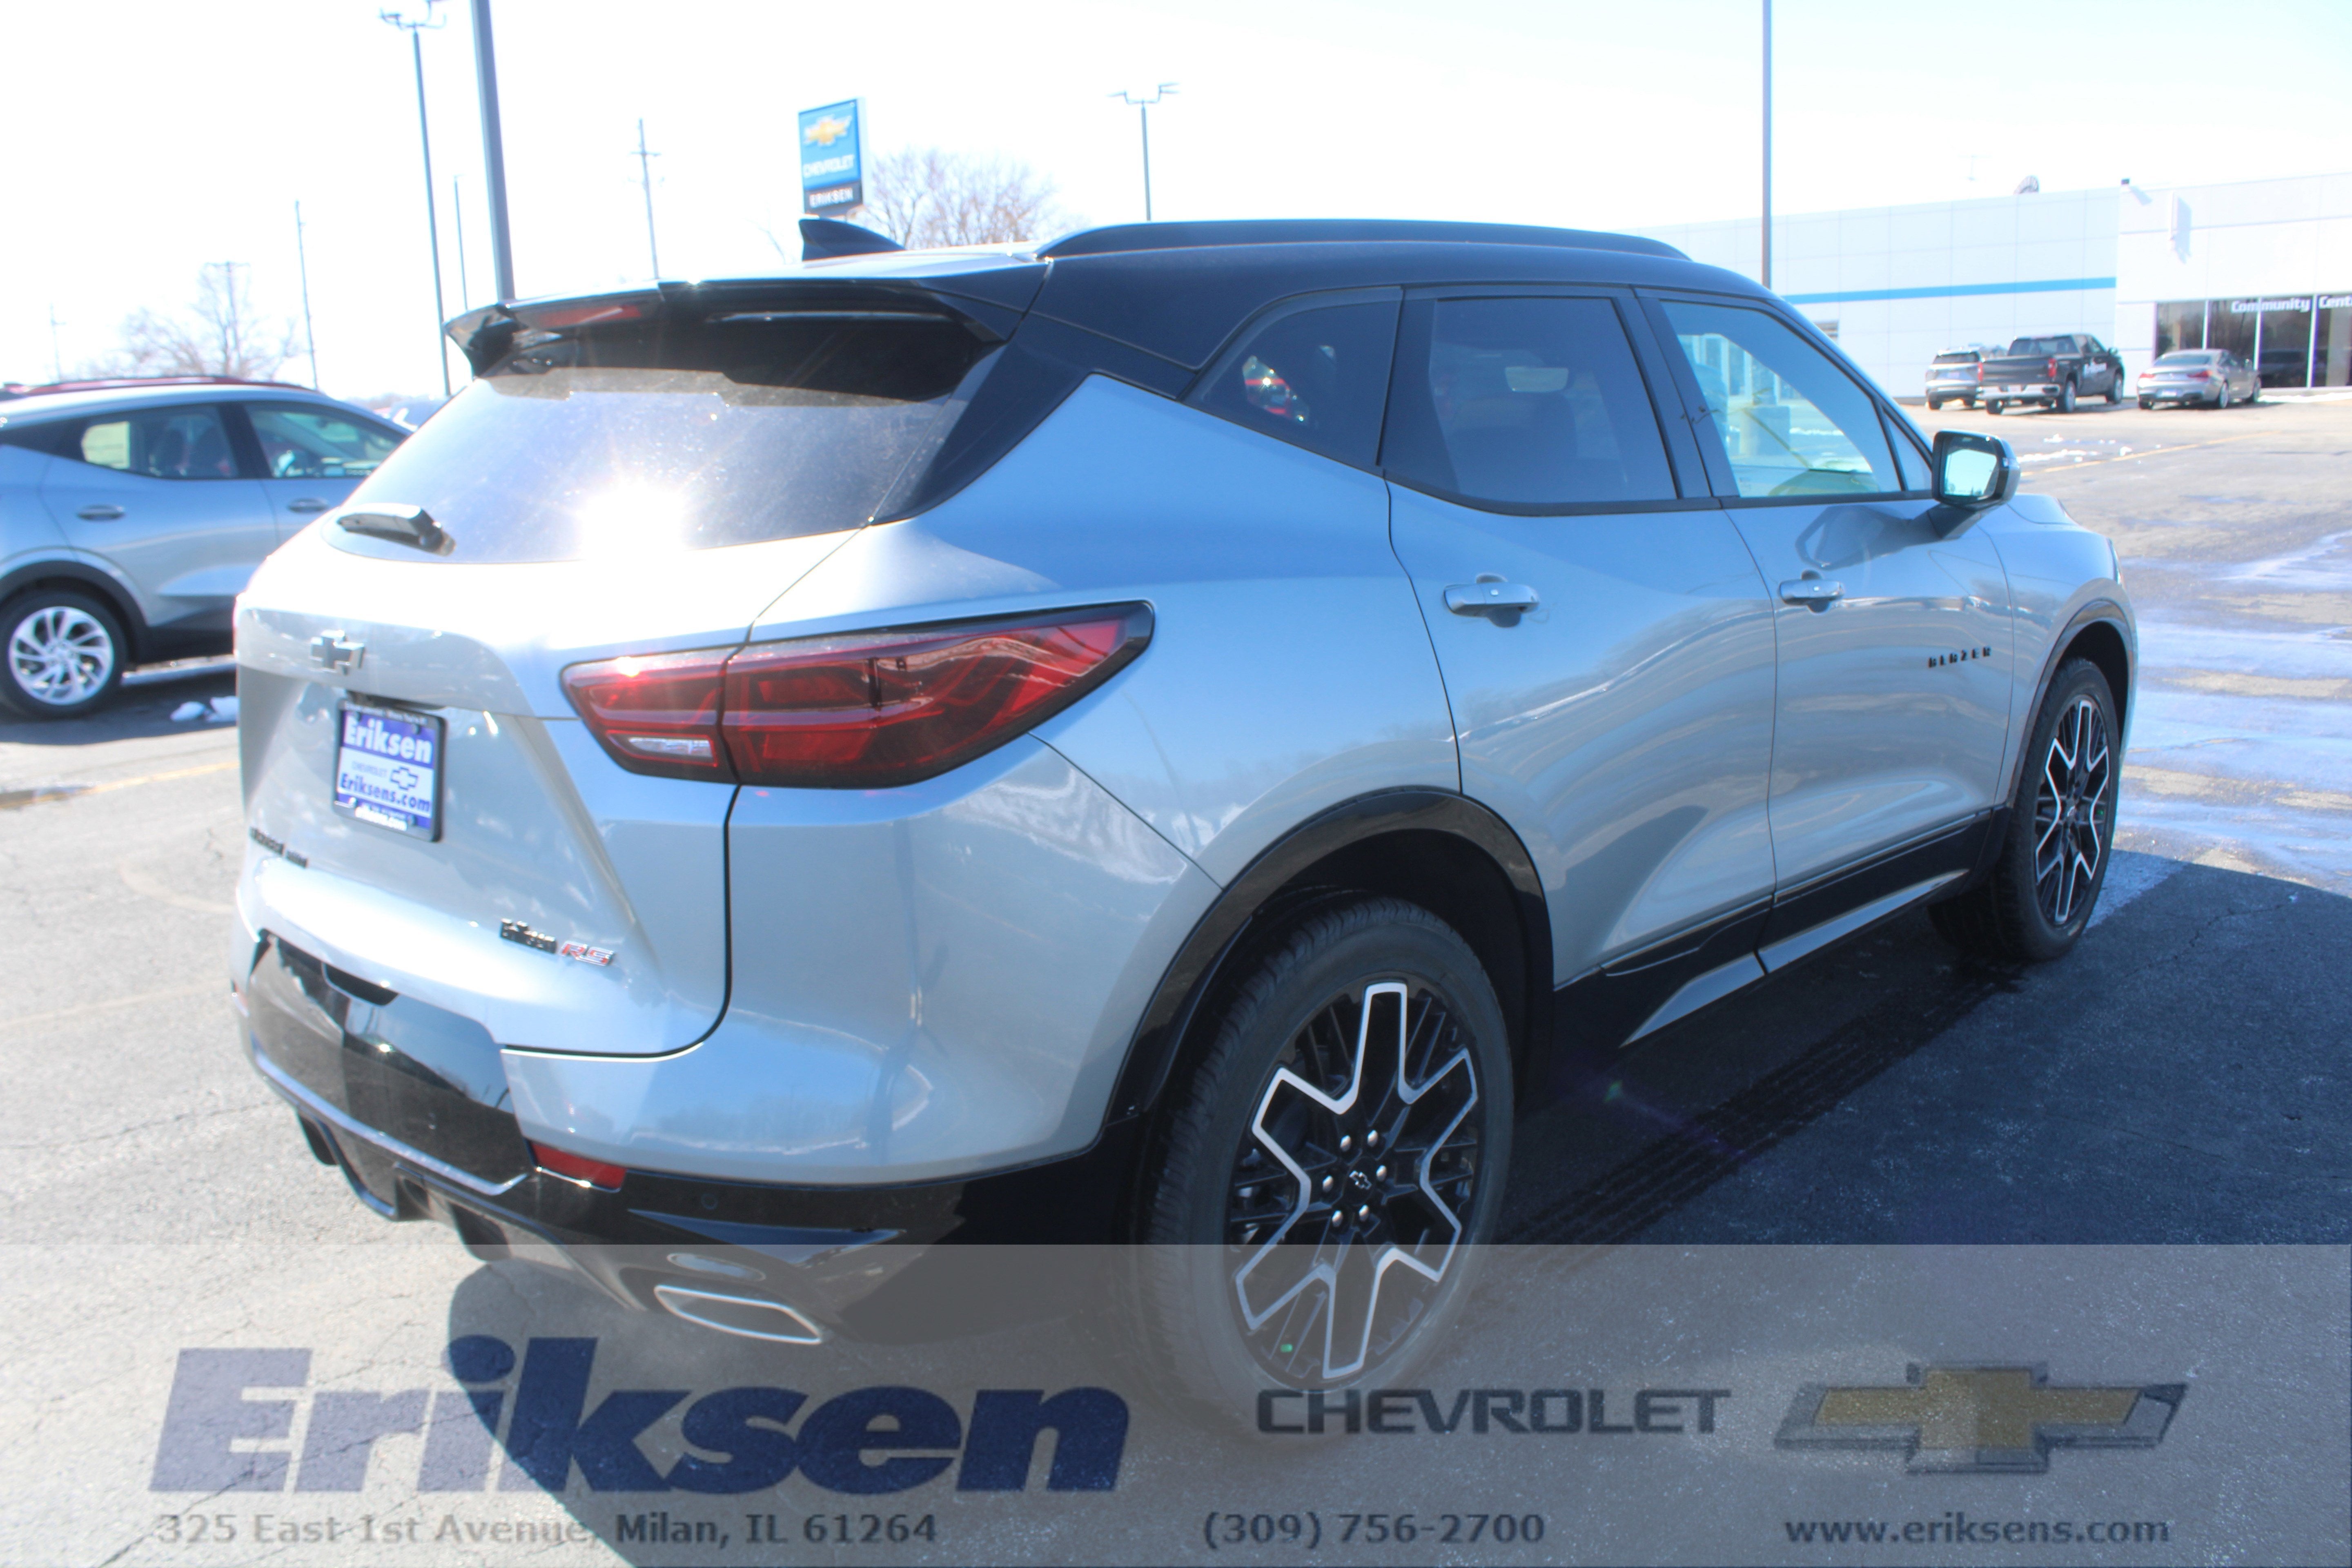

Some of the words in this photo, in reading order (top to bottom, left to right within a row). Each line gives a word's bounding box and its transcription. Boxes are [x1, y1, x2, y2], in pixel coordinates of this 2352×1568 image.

[2231, 297, 2311, 313] Community
[1928, 646, 1991, 668] BLAZER
[344, 714, 433, 764] Eriksen
[341, 773, 431, 812] Eriksens.com
[561, 940, 615, 967] RS
